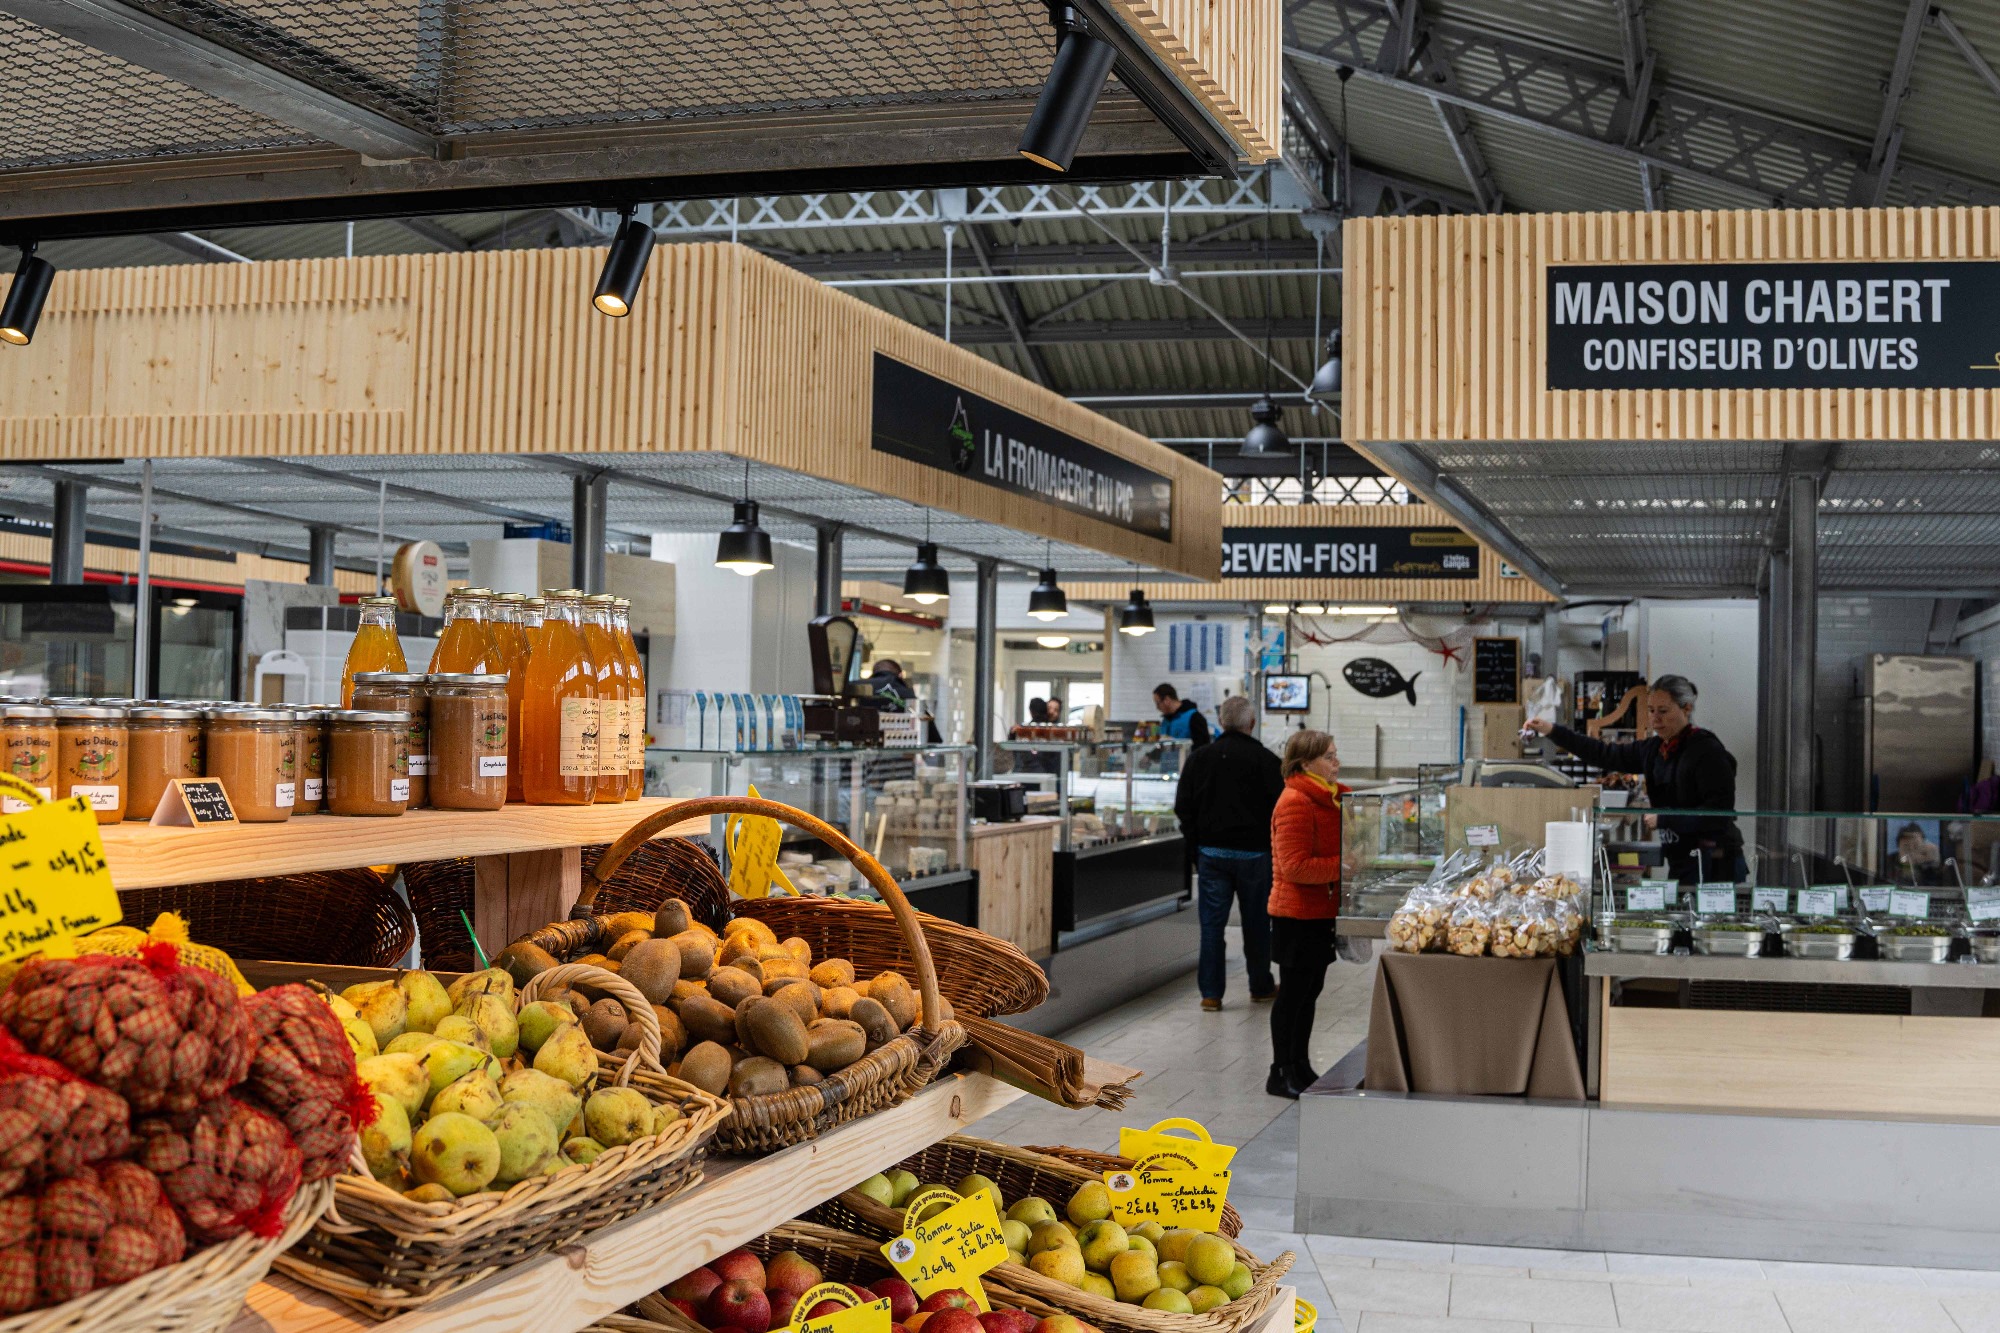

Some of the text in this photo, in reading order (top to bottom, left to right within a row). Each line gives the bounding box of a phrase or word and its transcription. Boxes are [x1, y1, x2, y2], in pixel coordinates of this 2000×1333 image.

[1555, 279, 1950, 325] MAISON CHABERT
[1583, 336, 1919, 372] CONFISEUR D'OLIVES
[984, 428, 1005, 480] LA
[1007, 438, 1095, 511] FROMAGERIE
[1096, 473, 1114, 516] DU
[1115, 480, 1134, 523] PIC
[75, 737, 91, 747] Les
[1134, 1152, 1199, 1172] Nos amis producteurs
[1139, 1172, 1174, 1184] Pomme
[905, 1191, 961, 1230] Nos amis producteurs
[915, 1222, 953, 1243] Pomme
[957, 1221, 985, 1239] Julia
[793, 1285, 860, 1323] Nos amis producteurs
